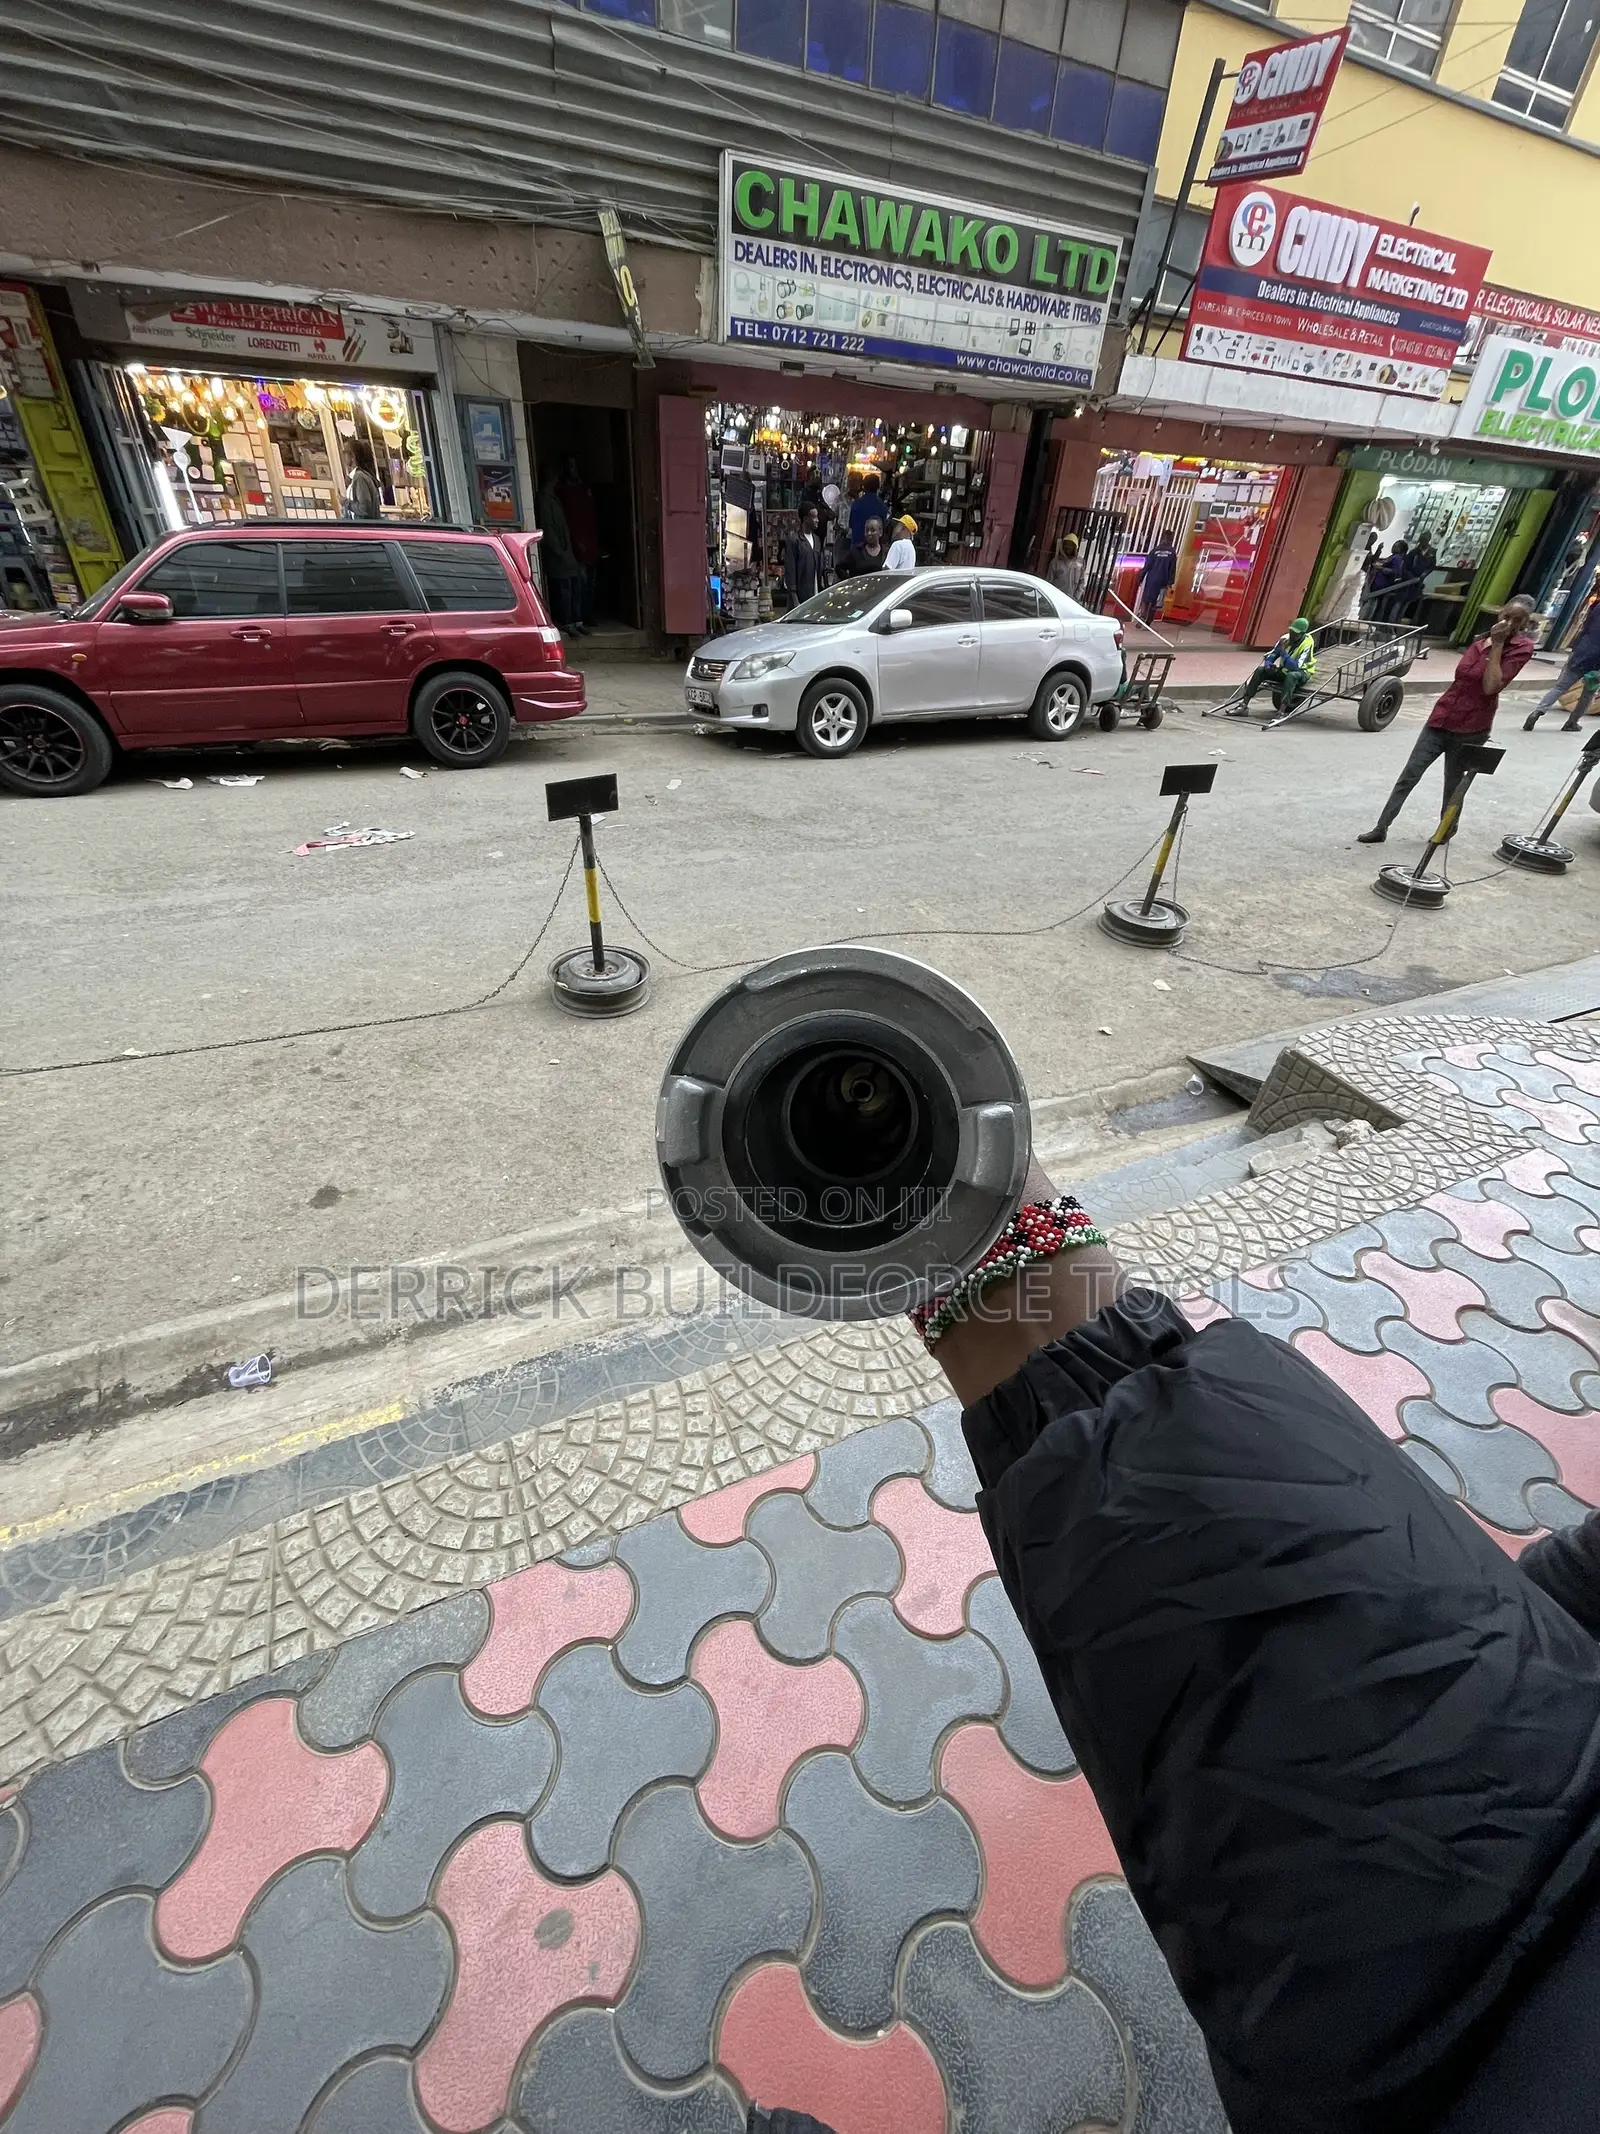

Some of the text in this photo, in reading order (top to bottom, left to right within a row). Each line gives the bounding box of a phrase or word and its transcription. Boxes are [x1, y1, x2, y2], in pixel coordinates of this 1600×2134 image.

[1257, 34, 1342, 100] CINDY
[734, 169, 1117, 295] CHAWAKO LTD
[1277, 205, 1379, 289] CINDY
[1375, 233, 1456, 275] ELECTRICAL
[735, 241, 797, 271] DEALERS
[820, 255, 915, 295] ELECTRONICS,
[917, 273, 995, 306] ELECTRICALS
[995, 290, 1005, 308] &
[1006, 291, 1069, 319] HARDWARE
[1073, 303, 1102, 326] ITEMS
[1257, 279, 1401, 326] Dealers in: Electrical Appliances
[1365, 267, 1468, 310] MARKETING LTD
[230, 302, 338, 327] ELECTRICALS
[260, 319, 322, 337] Electricals
[1197, 301, 1293, 326] UNBEATABLE PRICES IN TOWN
[1485, 291, 1543, 322] ELECTRICAL
[1544, 303, 1552, 324] &
[1552, 306, 1584, 332] SOLAR
[184, 326, 236, 343] Schneider
[247, 336, 300, 353] LORENZETTI
[734, 320, 865, 352] TEL: 0712 721 222
[1349, 327, 1357, 340] &
[1484, 347, 1600, 421] PLO
[1377, 449, 1453, 477] PLODAN
